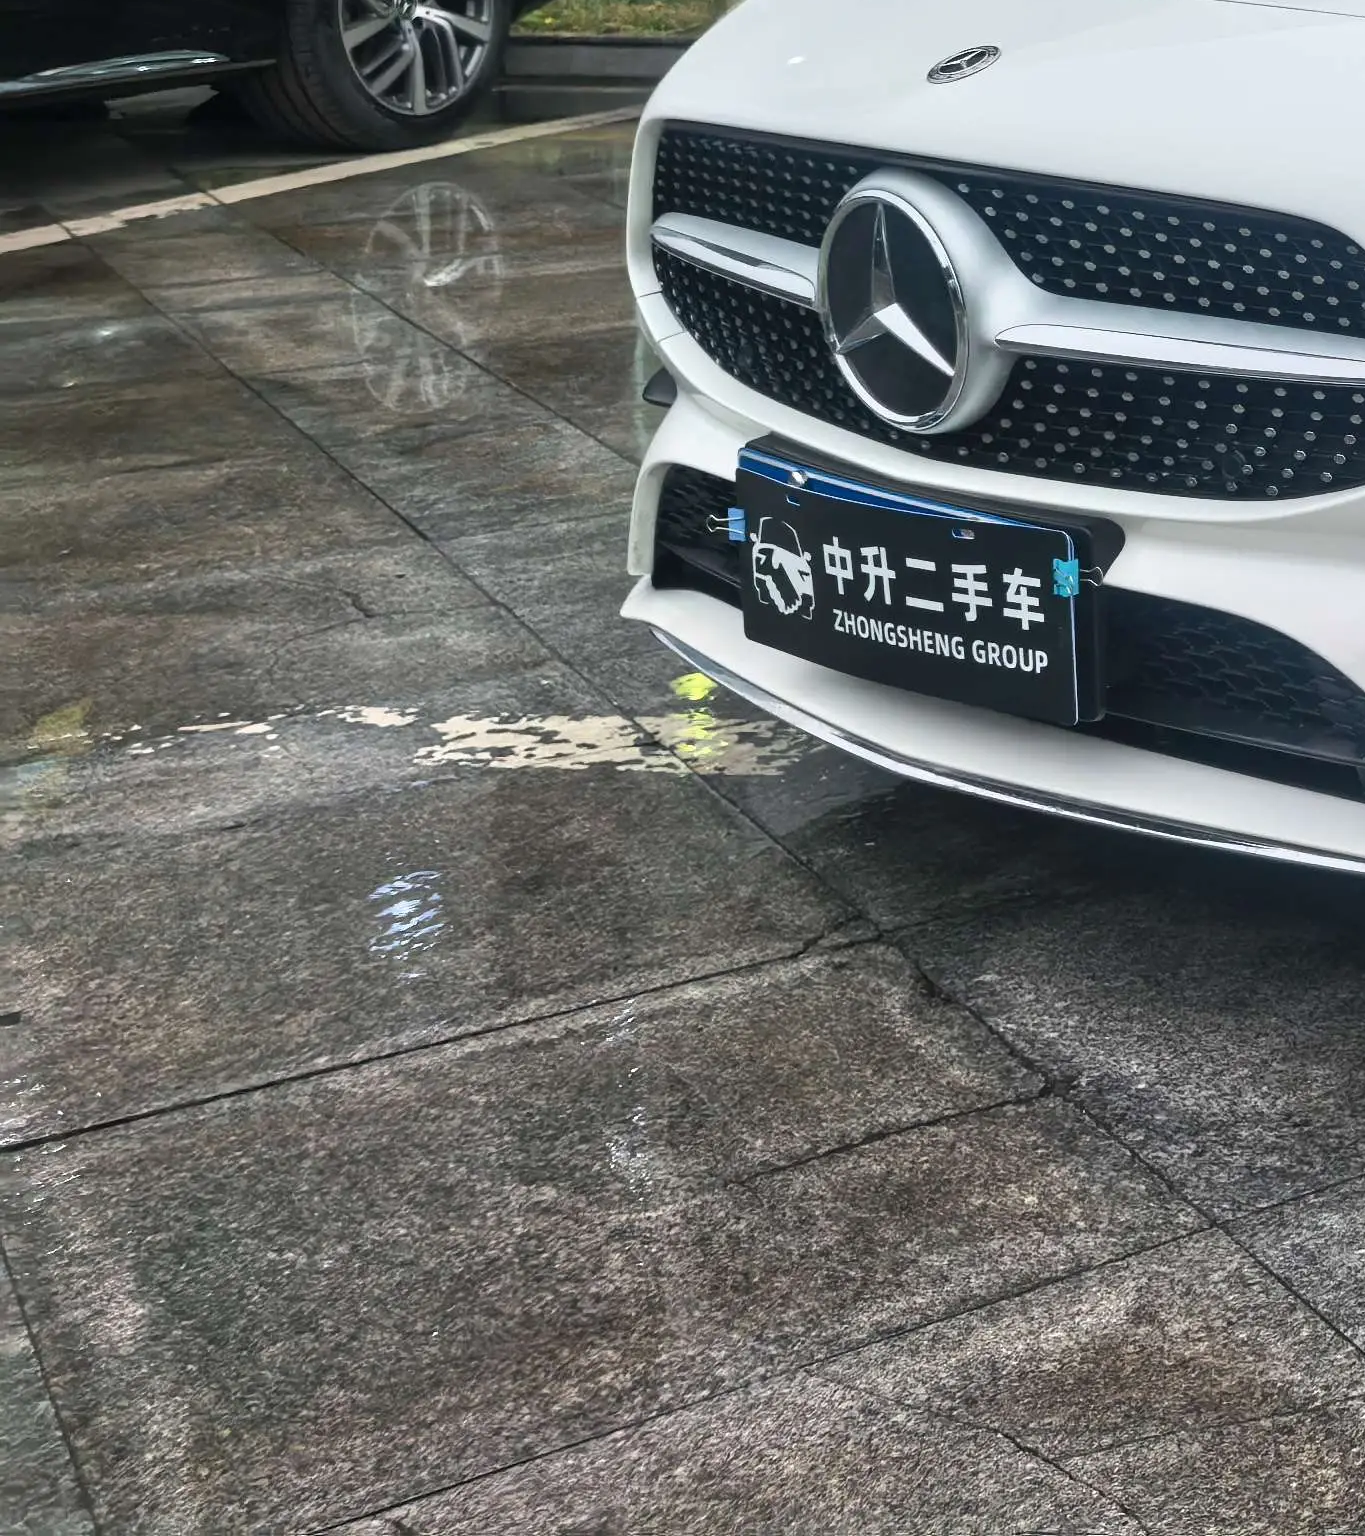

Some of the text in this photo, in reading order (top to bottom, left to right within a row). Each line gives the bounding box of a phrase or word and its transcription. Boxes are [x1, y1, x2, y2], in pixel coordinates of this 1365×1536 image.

[823, 536, 1045, 631] 中升二手车
[832, 608, 1048, 674] ZHONGSHENG GROUP
